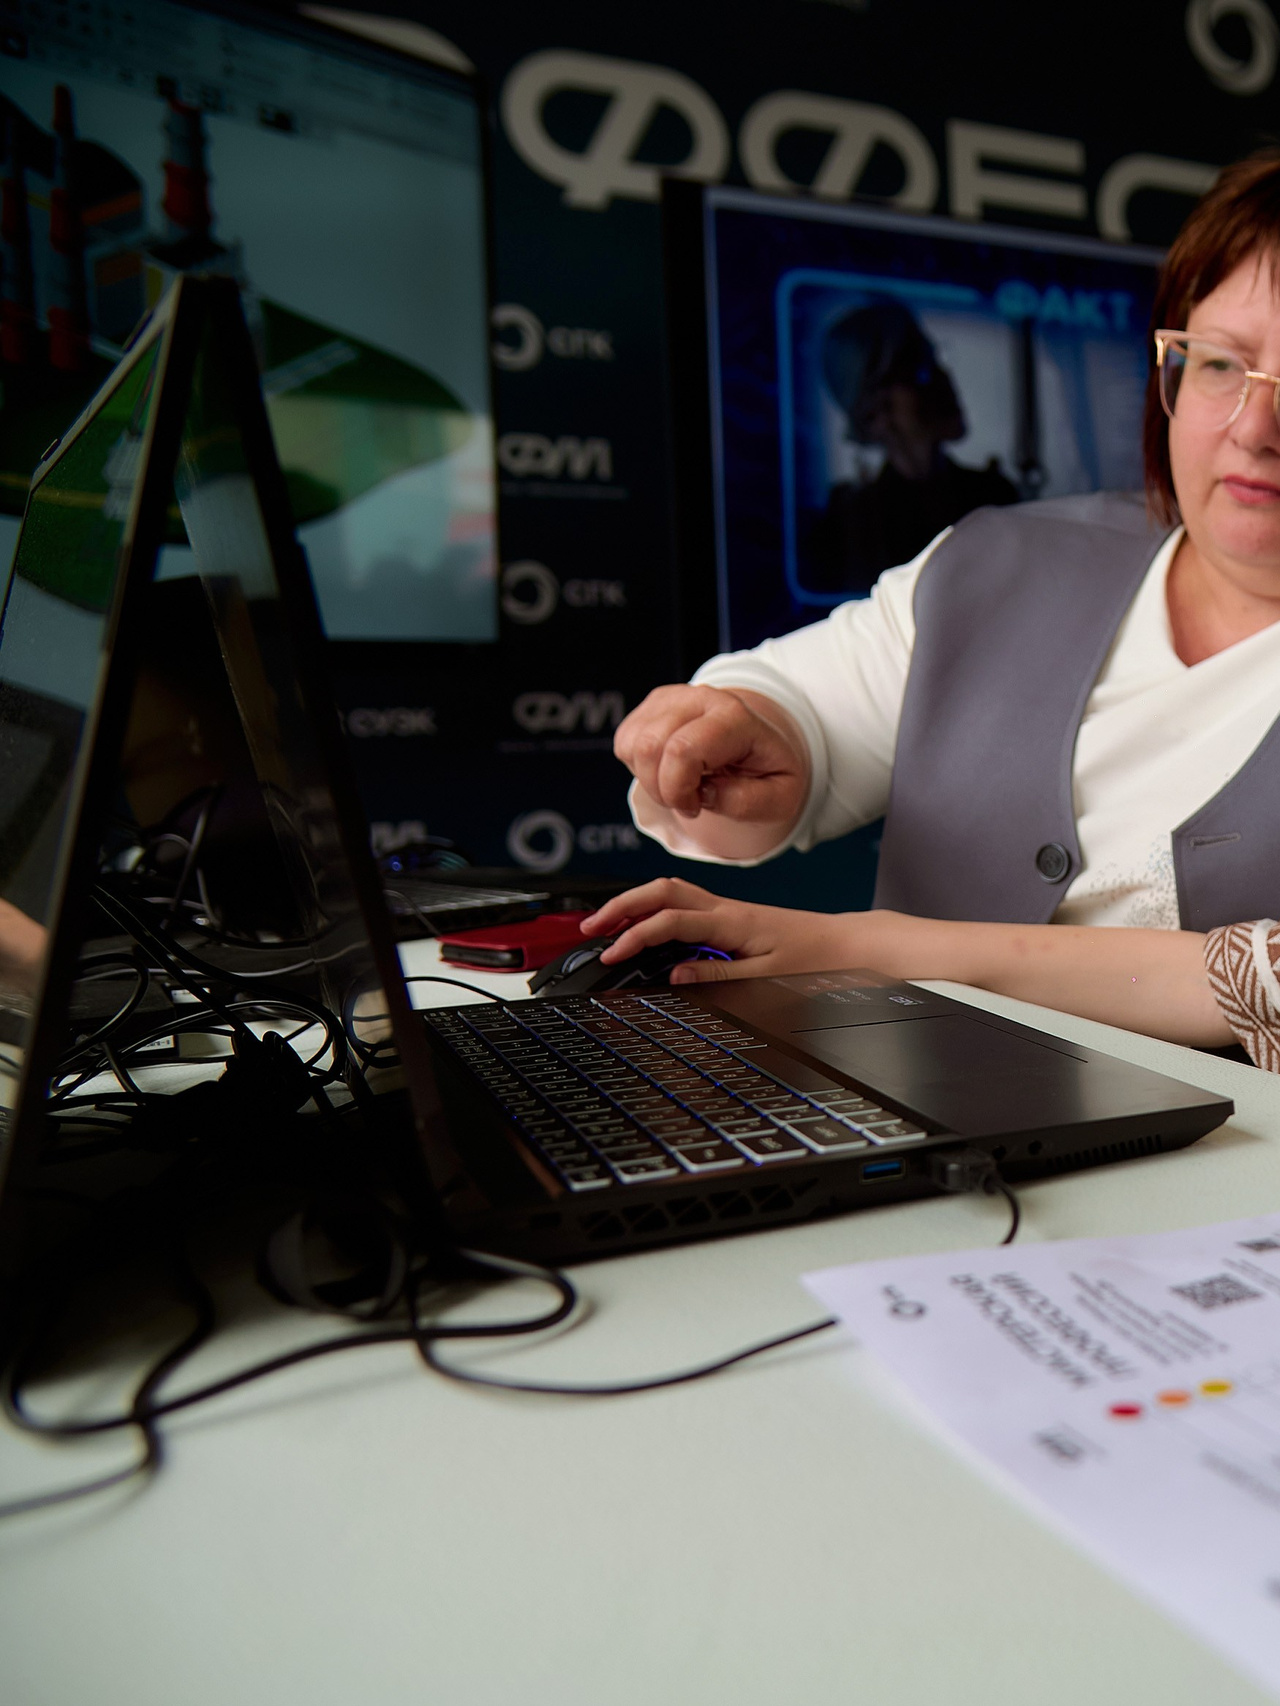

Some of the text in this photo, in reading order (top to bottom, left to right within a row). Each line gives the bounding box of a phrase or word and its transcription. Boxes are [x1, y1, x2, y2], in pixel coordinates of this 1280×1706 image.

[992, 276, 1134, 333] ФАКТ
[545, 325, 614, 361] СГК
[562, 578, 626, 608] СГК
[577, 822, 642, 856] СГК
